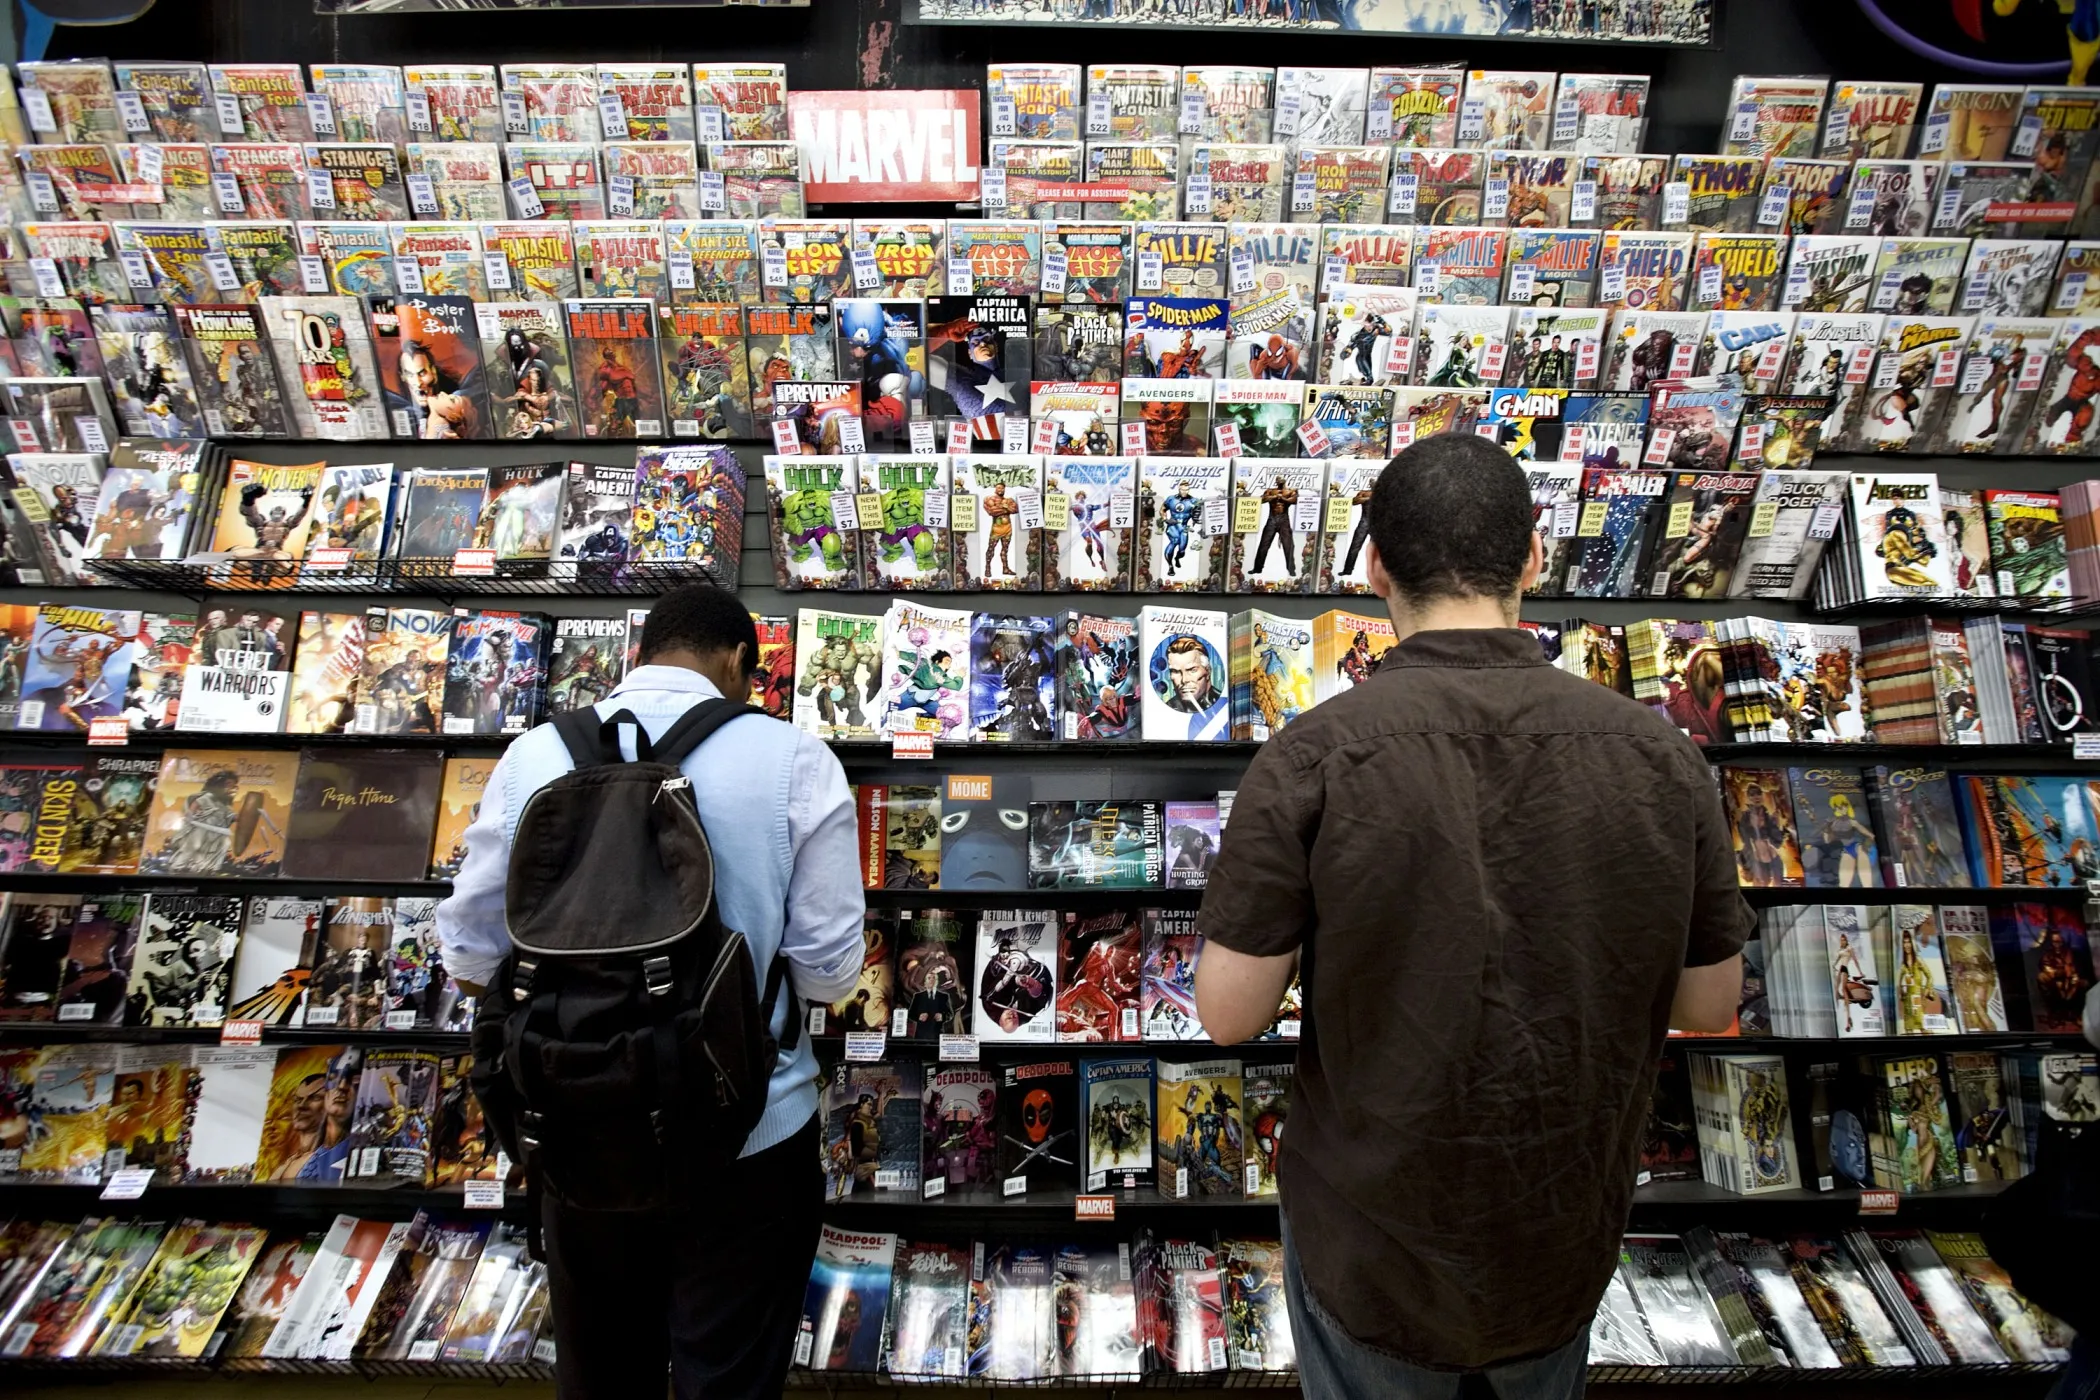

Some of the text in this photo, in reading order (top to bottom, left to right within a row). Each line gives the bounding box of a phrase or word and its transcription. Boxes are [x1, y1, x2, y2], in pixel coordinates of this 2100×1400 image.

[227, 70, 296, 93] Fantastic
[607, 126, 625, 135] $14
[1090, 124, 1108, 132] $22
[794, 110, 977, 183] MARVEL
[227, 149, 292, 167] STRANGE
[322, 151, 385, 168] STRANGE
[1396, 175, 1416, 186] THOR
[1691, 162, 1752, 191] THOR
[1488, 181, 1507, 191] THOR
[1576, 183, 1593, 193] THOR
[1038, 188, 1129, 199] PLEASE ASK FOR ASSISTANCE
[525, 207, 542, 216] $17
[1295, 202, 1312, 210] $35
[220, 230, 288, 246] Fantastic
[407, 237, 472, 252] Fantastic
[1431, 234, 1450, 245] NEW
[1526, 237, 1547, 248] NEW
[500, 238, 567, 263] FANTASTIC
[592, 237, 660, 264] FANTASTIC
[967, 243, 1029, 259] IRON
[518, 260, 554, 269] FOUR
[1713, 242, 1777, 276] SHIELD
[878, 259, 932, 276] FIST
[972, 260, 1030, 277] FIST
[1068, 261, 1122, 277] FIST
[859, 278, 877, 287] $10
[976, 298, 1018, 308] CAPTAIN
[1512, 292, 1529, 300] $12
[1701, 292, 1718, 300] $35
[408, 298, 466, 318] Poster
[498, 308, 542, 318] MARVEL
[967, 307, 1027, 323] AMERICA
[1147, 300, 1222, 326] SPIDER-MAN
[189, 309, 254, 332] HOWLING
[544, 312, 559, 333] 4
[676, 312, 742, 336] HULK
[748, 312, 815, 336] HULK
[1073, 315, 1108, 329] BLACK
[1235, 298, 1298, 336] SPIDER-MAN
[284, 309, 332, 352] 70
[422, 317, 464, 334] Book
[570, 312, 650, 338] HULK
[1809, 321, 1874, 342] PUNISHER
[196, 331, 257, 341] COMMANDOS
[886, 330, 918, 338] REBORN
[1719, 322, 1786, 352] CABLE
[1899, 328, 1962, 351] MARVEL
[1396, 338, 1410, 347] NEW
[1394, 350, 1408, 359] THIS
[1489, 346, 1504, 354] NEW
[1388, 362, 1409, 372] MONTH
[1486, 357, 1502, 366] THIS
[784, 385, 852, 402] PREVIEWS
[1038, 382, 1106, 395] Adventures
[1138, 389, 1194, 398] AVENGERS
[1231, 391, 1287, 400] SPIDER-MAN
[1045, 396, 1102, 412] AVENGERS
[1494, 394, 1559, 418] G-MAN
[1758, 396, 1828, 411] DESCENDANT
[777, 421, 790, 431] NEW
[780, 432, 797, 442] THIS
[844, 443, 864, 452] $12
[1009, 442, 1022, 451] $7
[159, 461, 194, 472] WAR
[1158, 466, 1225, 478] FANTASTIC
[26, 464, 96, 486] NOVA
[334, 467, 386, 491] CABLE
[505, 468, 544, 480] HULK
[783, 466, 842, 491] HULK
[879, 466, 938, 490] HULK
[1248, 472, 1318, 493] AVENGERS
[1692, 474, 1758, 491] RED SONJA
[1782, 482, 1826, 494] BUCK
[1867, 477, 1930, 503] AVENGERS
[861, 504, 879, 512] ITEM
[955, 505, 973, 513] ITEM
[1588, 504, 1605, 512] NEW
[1769, 496, 1830, 509] ROGERS
[863, 512, 879, 520] THIS
[929, 518, 942, 526] $7
[1116, 517, 1128, 525] $7
[1585, 519, 1601, 527] THIS
[1587, 512, 1603, 520] ITEM
[840, 519, 853, 528] $7
[861, 520, 883, 528] WEEK
[1210, 526, 1223, 534] $7
[1237, 523, 1258, 531] WEEK
[1300, 522, 1314, 530] $7
[1580, 527, 1601, 535] WEEK
[1811, 529, 1831, 538] $10
[310, 551, 349, 563] MARVEL
[1149, 612, 1208, 626] FANTASTIC
[1345, 617, 1394, 635] DEADPOOL
[564, 619, 625, 638] PREVIEWS
[816, 621, 876, 644] HULK
[1080, 619, 1132, 636] GUARDIANS
[1161, 622, 1194, 634] FOUR
[215, 649, 273, 671] SECRET
[201, 671, 278, 696] WARRIORS
[894, 733, 933, 750] MARVEL
[951, 781, 989, 798] MOME
[321, 786, 400, 809] Roger Hane
[31, 780, 76, 865] SKIN DEEP
[868, 788, 882, 888] NELSON MANDELA
[1142, 803, 1158, 882] PATRICIA BRIGGS
[328, 906, 395, 925] PUNISHER
[223, 1022, 262, 1038] MARVEL
[1016, 1061, 1073, 1079] DEADPOOL
[1088, 1064, 1151, 1078] CAPTAIN AMERICA
[1184, 1067, 1227, 1077] AVENGERS
[1886, 1058, 1938, 1086] HERO
[936, 1072, 993, 1086] DEADPOOL
[1077, 1199, 1114, 1215] MARVEL
[1860, 1192, 1898, 1209] MARVEL
[822, 1227, 887, 1246] DEADPOOL:
[1165, 1241, 1197, 1254] BLACK
[1162, 1251, 1207, 1270] PANTHER
[1012, 1266, 1045, 1275] REBORN
